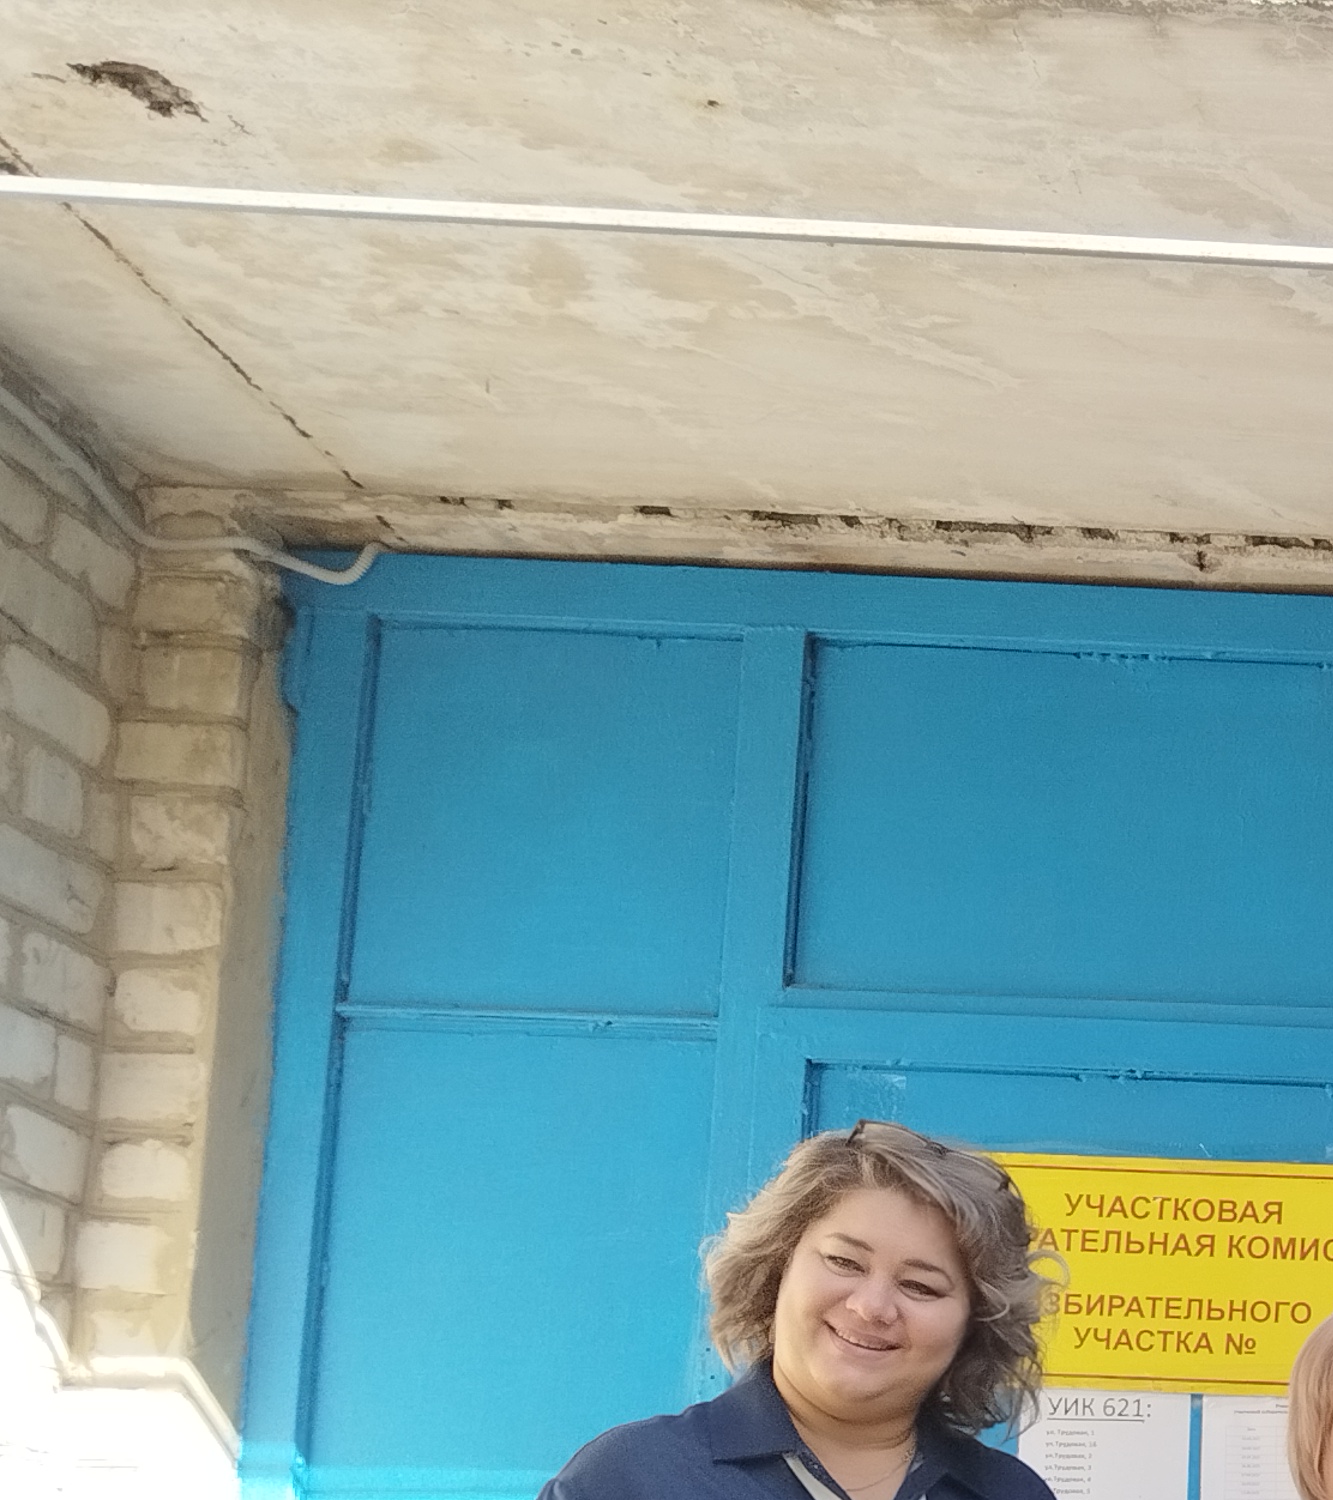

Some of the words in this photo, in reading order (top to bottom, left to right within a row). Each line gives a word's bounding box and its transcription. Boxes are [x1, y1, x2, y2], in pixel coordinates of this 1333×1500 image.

[1063, 1192, 1284, 1225] УЧАСТКОВАЯ
[1044, 1290, 1312, 1325] ЗБИРАТЕЛЬНОГО
[1073, 1326, 1215, 1355] УЧАСТКА
[1224, 1332, 1257, 1355] №
[1047, 1396, 1096, 1417] УИК
[1102, 1397, 1152, 1418] 621:
